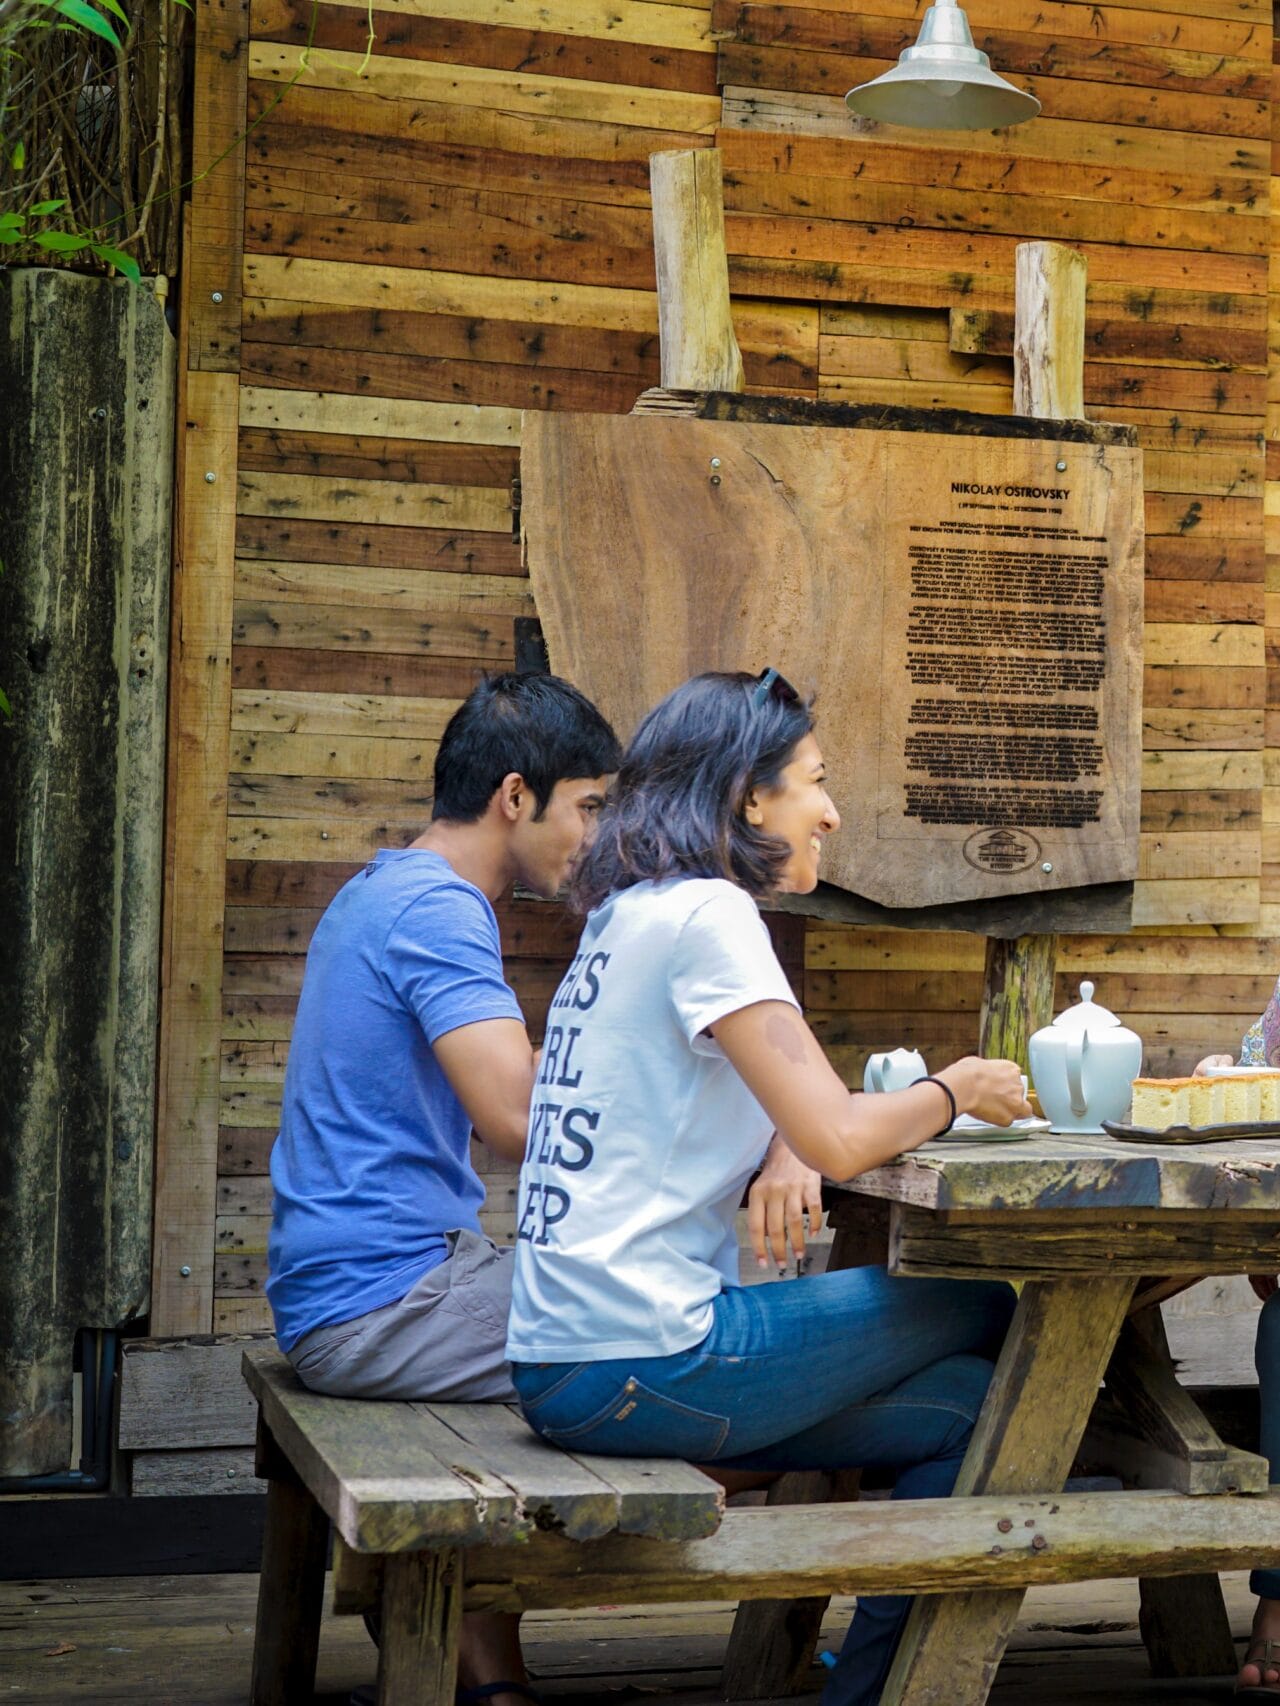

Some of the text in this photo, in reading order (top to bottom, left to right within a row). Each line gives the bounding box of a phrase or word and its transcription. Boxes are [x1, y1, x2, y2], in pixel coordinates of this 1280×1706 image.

[951, 483, 1070, 500] NIKOLAY OSTROVSKY
[539, 1026, 583, 1088] RL
[518, 1183, 571, 1246] EP
